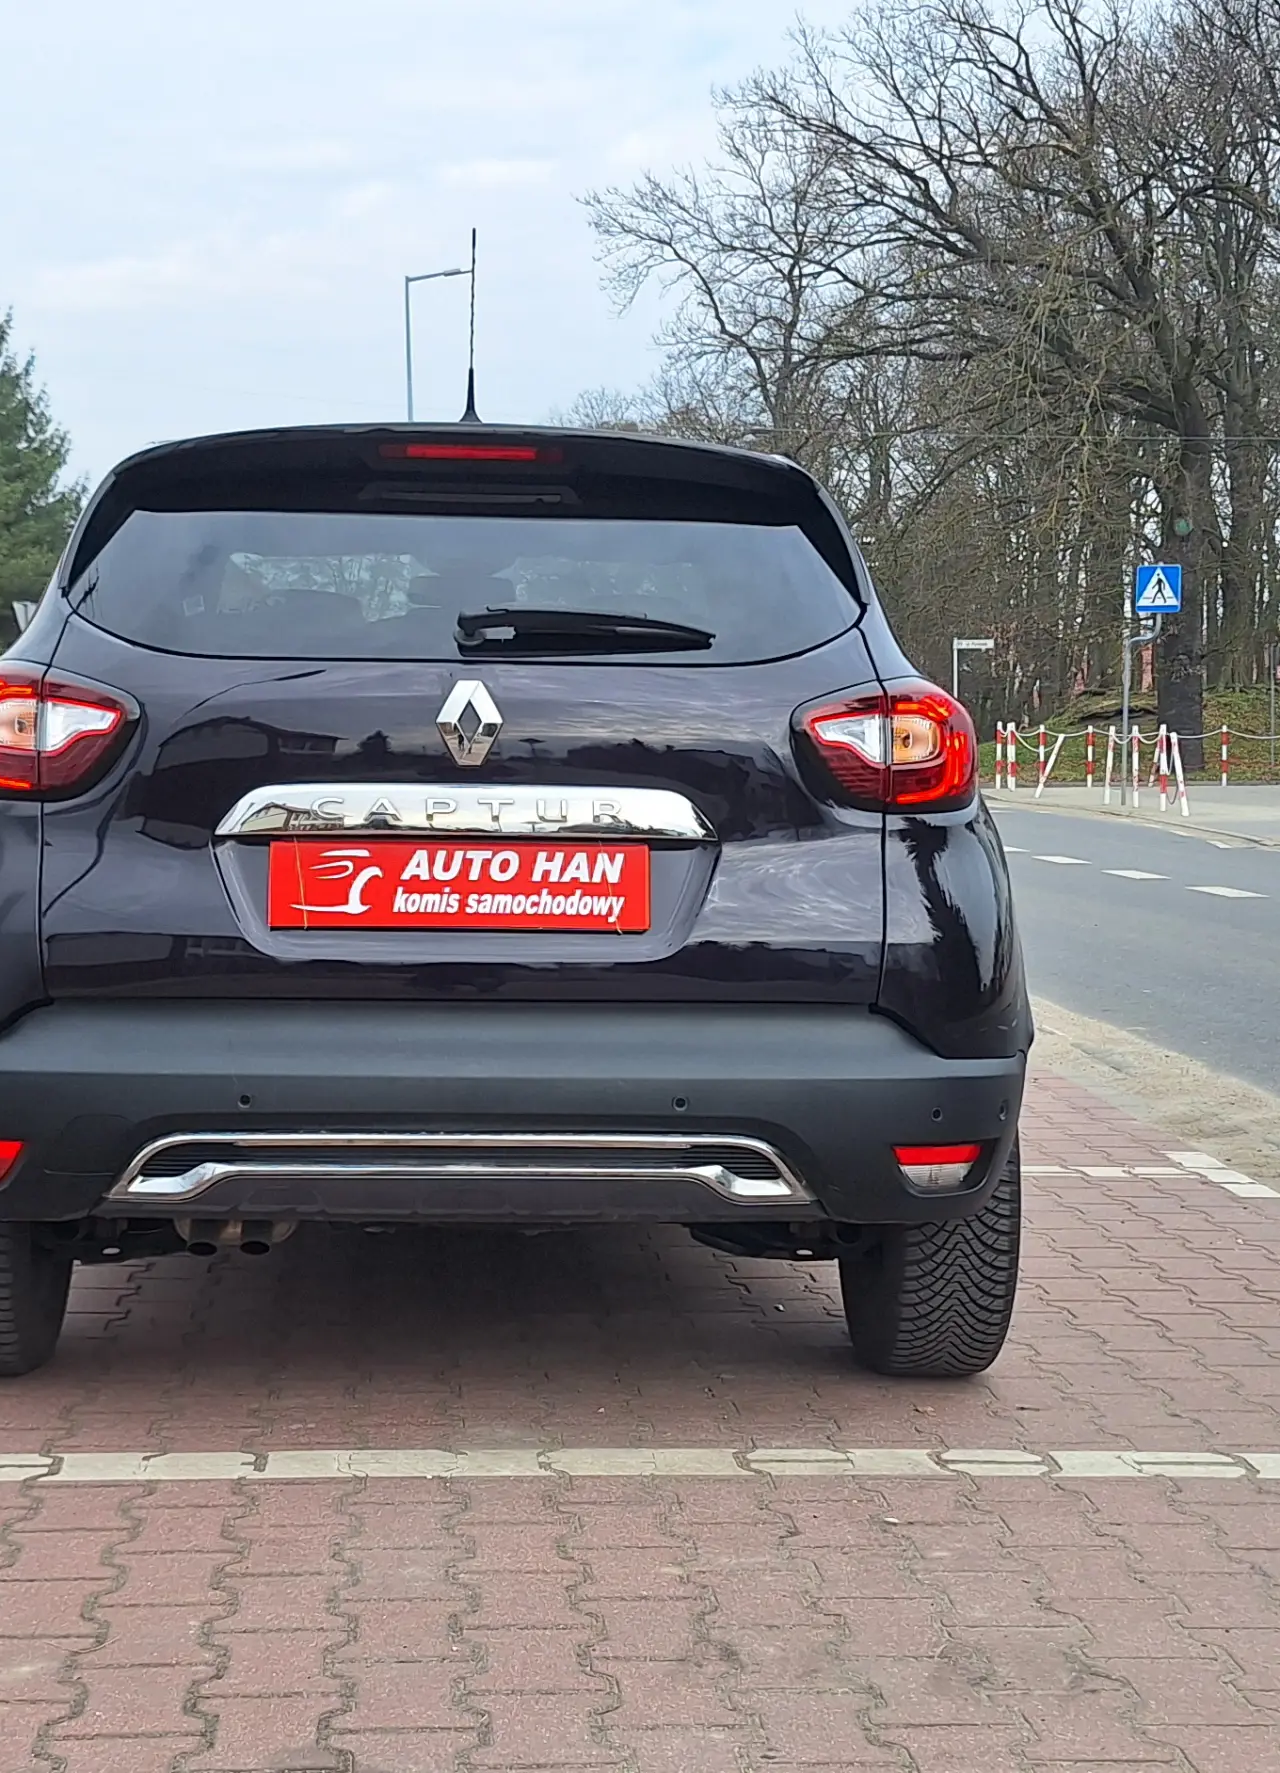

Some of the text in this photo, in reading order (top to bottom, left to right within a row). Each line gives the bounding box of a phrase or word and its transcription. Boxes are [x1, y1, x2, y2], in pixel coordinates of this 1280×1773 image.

[311, 797, 628, 824] CAPTUR
[400, 849, 625, 884] AUTO HAN
[393, 886, 625, 922] komis samochodowy
